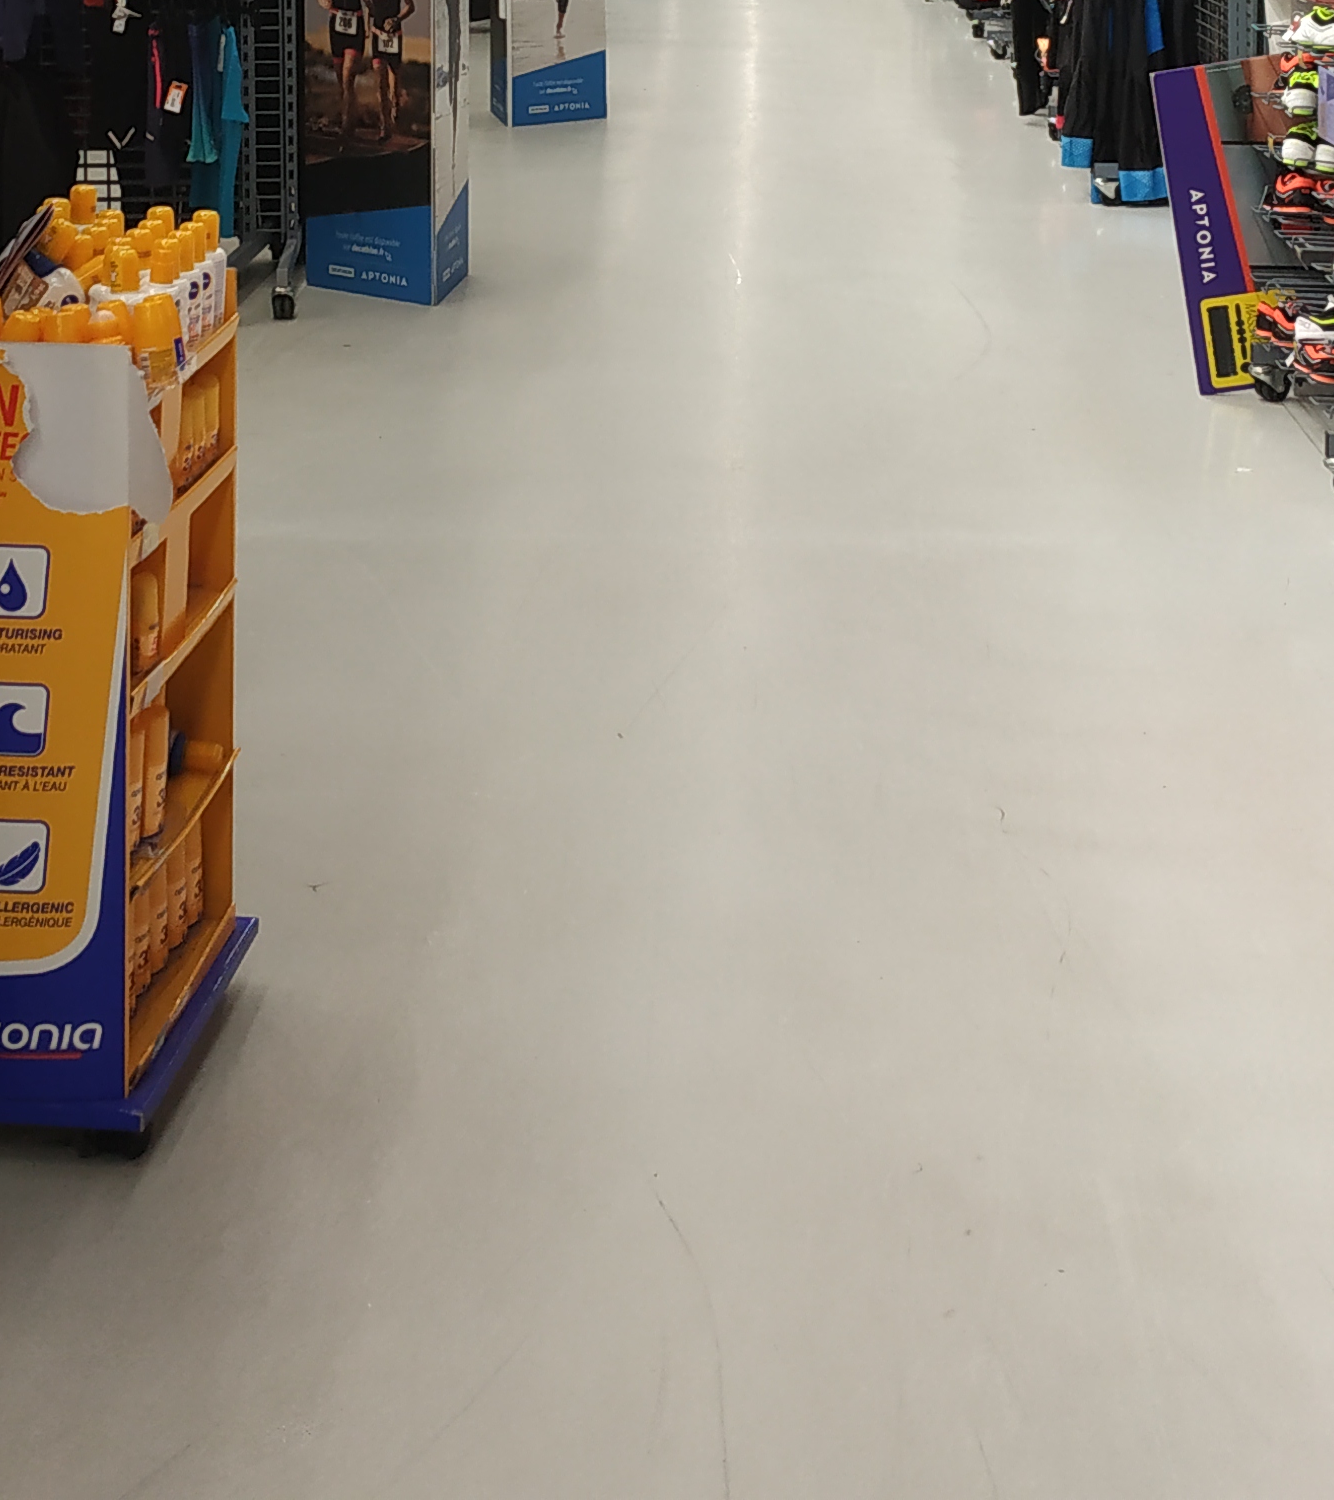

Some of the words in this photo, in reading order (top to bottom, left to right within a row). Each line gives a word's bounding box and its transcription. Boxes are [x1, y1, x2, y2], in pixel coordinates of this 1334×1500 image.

[553, 101, 590, 112] APTONIA
[1189, 189, 1217, 283] APTONIA
[361, 270, 408, 287] APTONIA
[33, 779, 67, 793] L'EAU
